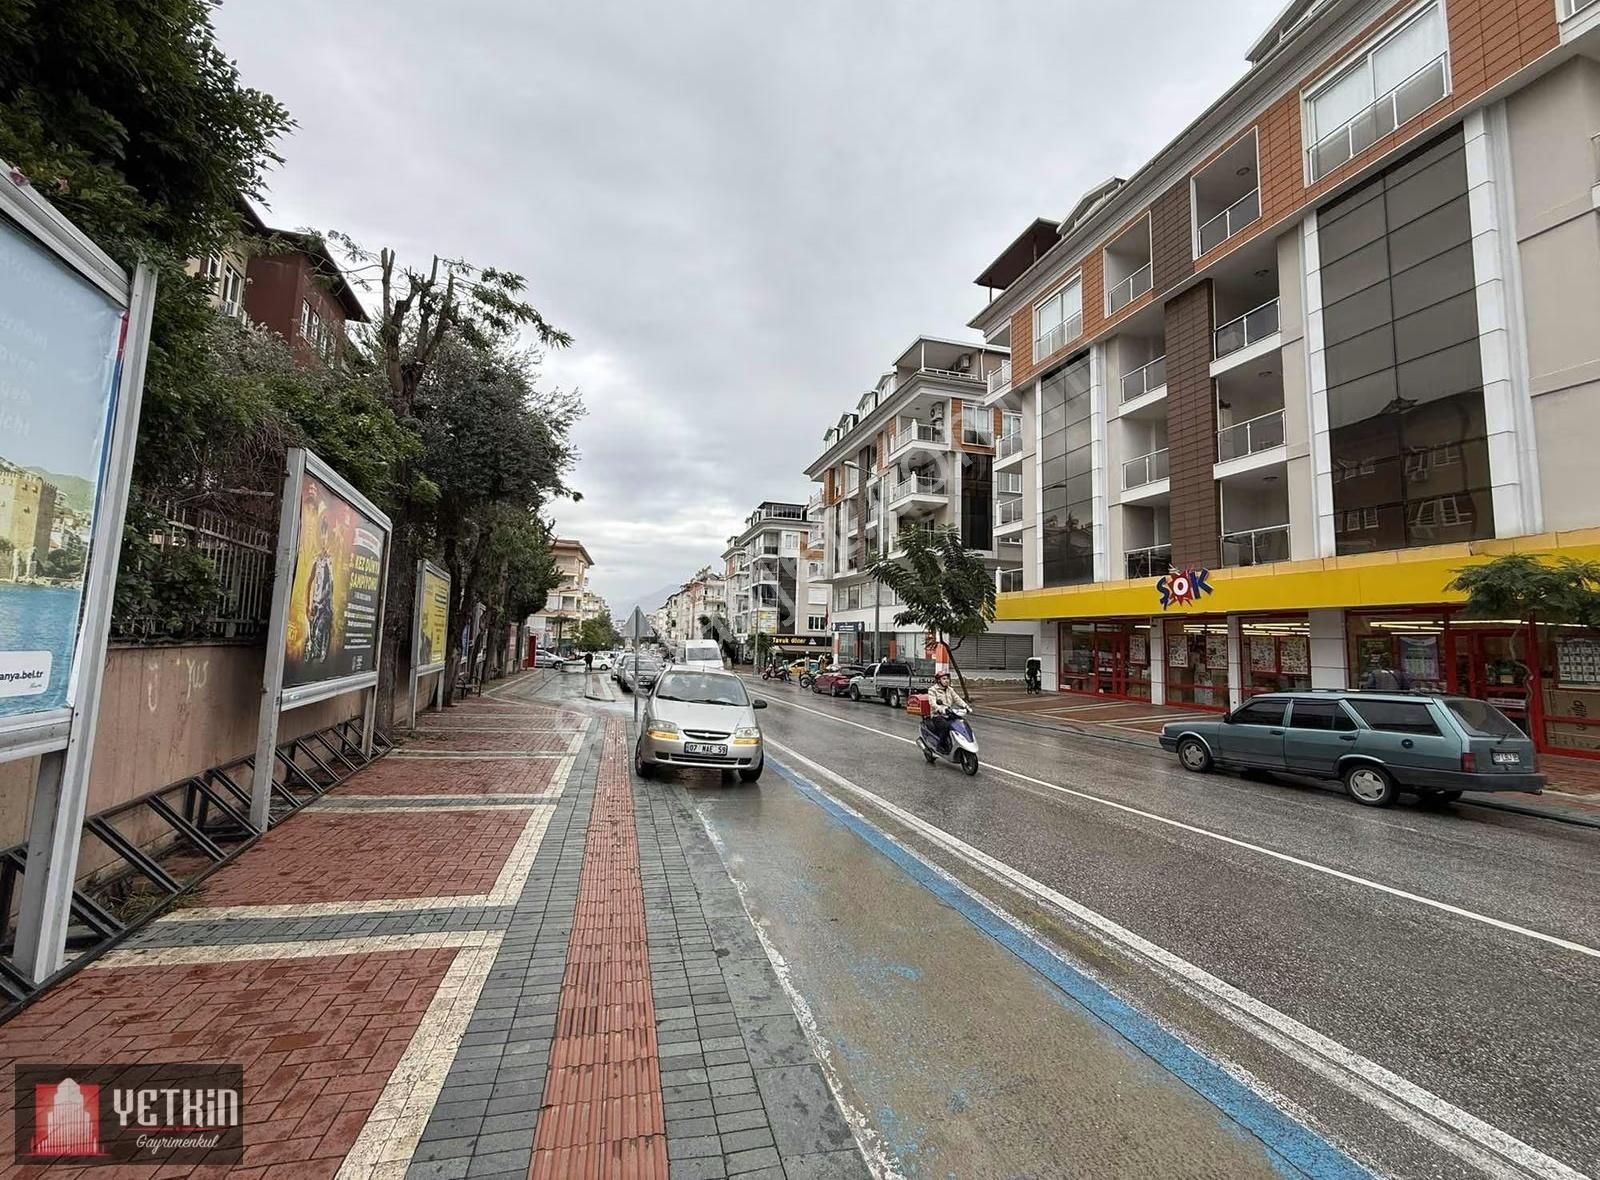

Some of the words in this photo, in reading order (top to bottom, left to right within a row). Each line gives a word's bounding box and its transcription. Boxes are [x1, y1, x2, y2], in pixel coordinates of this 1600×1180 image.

[1156, 567, 1214, 611] ŞOK
[772, 637, 789, 645] Tavuk
[689, 744, 697, 752] 07
